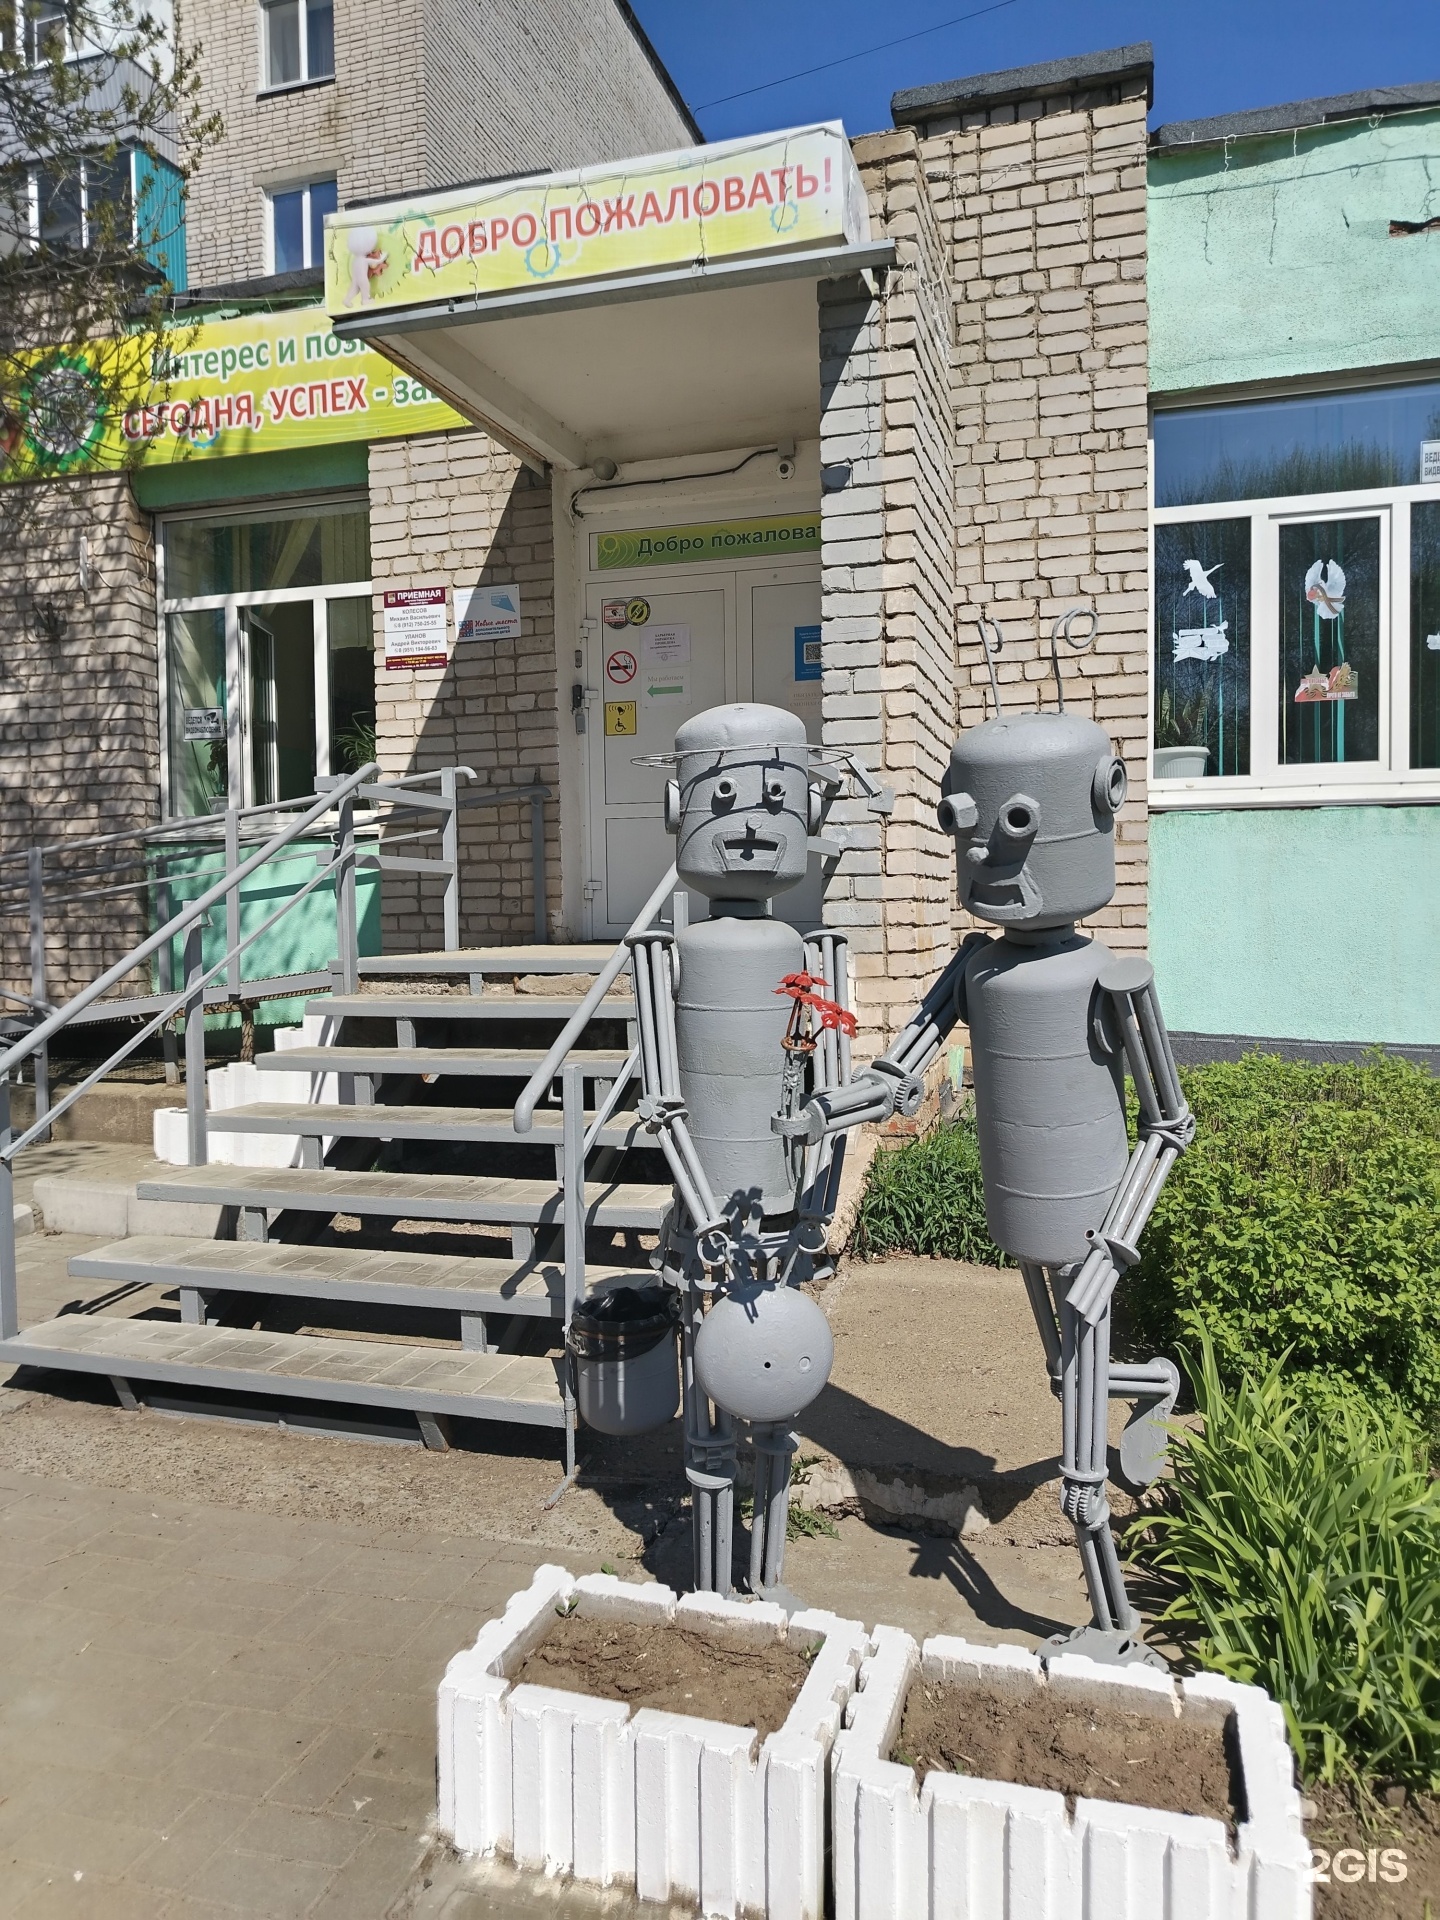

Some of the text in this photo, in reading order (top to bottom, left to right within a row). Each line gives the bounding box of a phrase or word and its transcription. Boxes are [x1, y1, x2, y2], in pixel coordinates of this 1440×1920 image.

[413, 157, 833, 272] ДОБРО ПОЖАЛОВАТЬ!
[151, 341, 269, 380] Интерес
[277, 339, 296, 363] и
[124, 394, 262, 438] СЕГОДНЯ,
[269, 378, 367, 421] УСПЕХ
[394, 379, 438, 404] за
[637, 535, 705, 558] Добро
[397, 589, 442, 601] ПРИЕМНАЯ
[402, 607, 428, 615] КОЛЕСОВ
[495, 618, 518, 626] места
